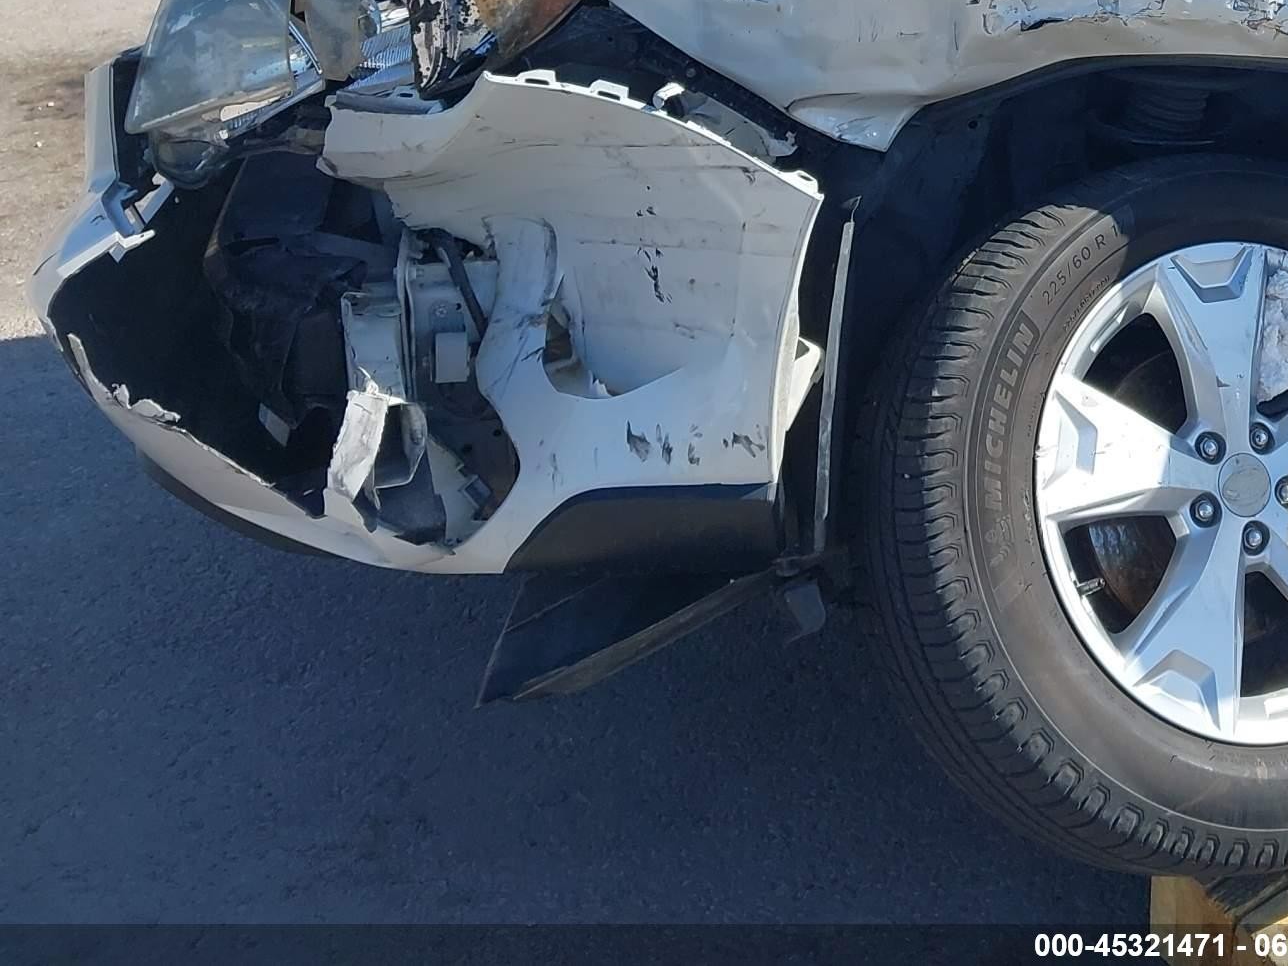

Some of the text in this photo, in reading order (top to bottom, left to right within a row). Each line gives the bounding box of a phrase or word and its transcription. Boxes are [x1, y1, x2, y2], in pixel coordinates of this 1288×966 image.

[1042, 246, 1092, 306] 225/60
[1094, 234, 1107, 250] R
[983, 322, 1036, 512] MICHELIN
